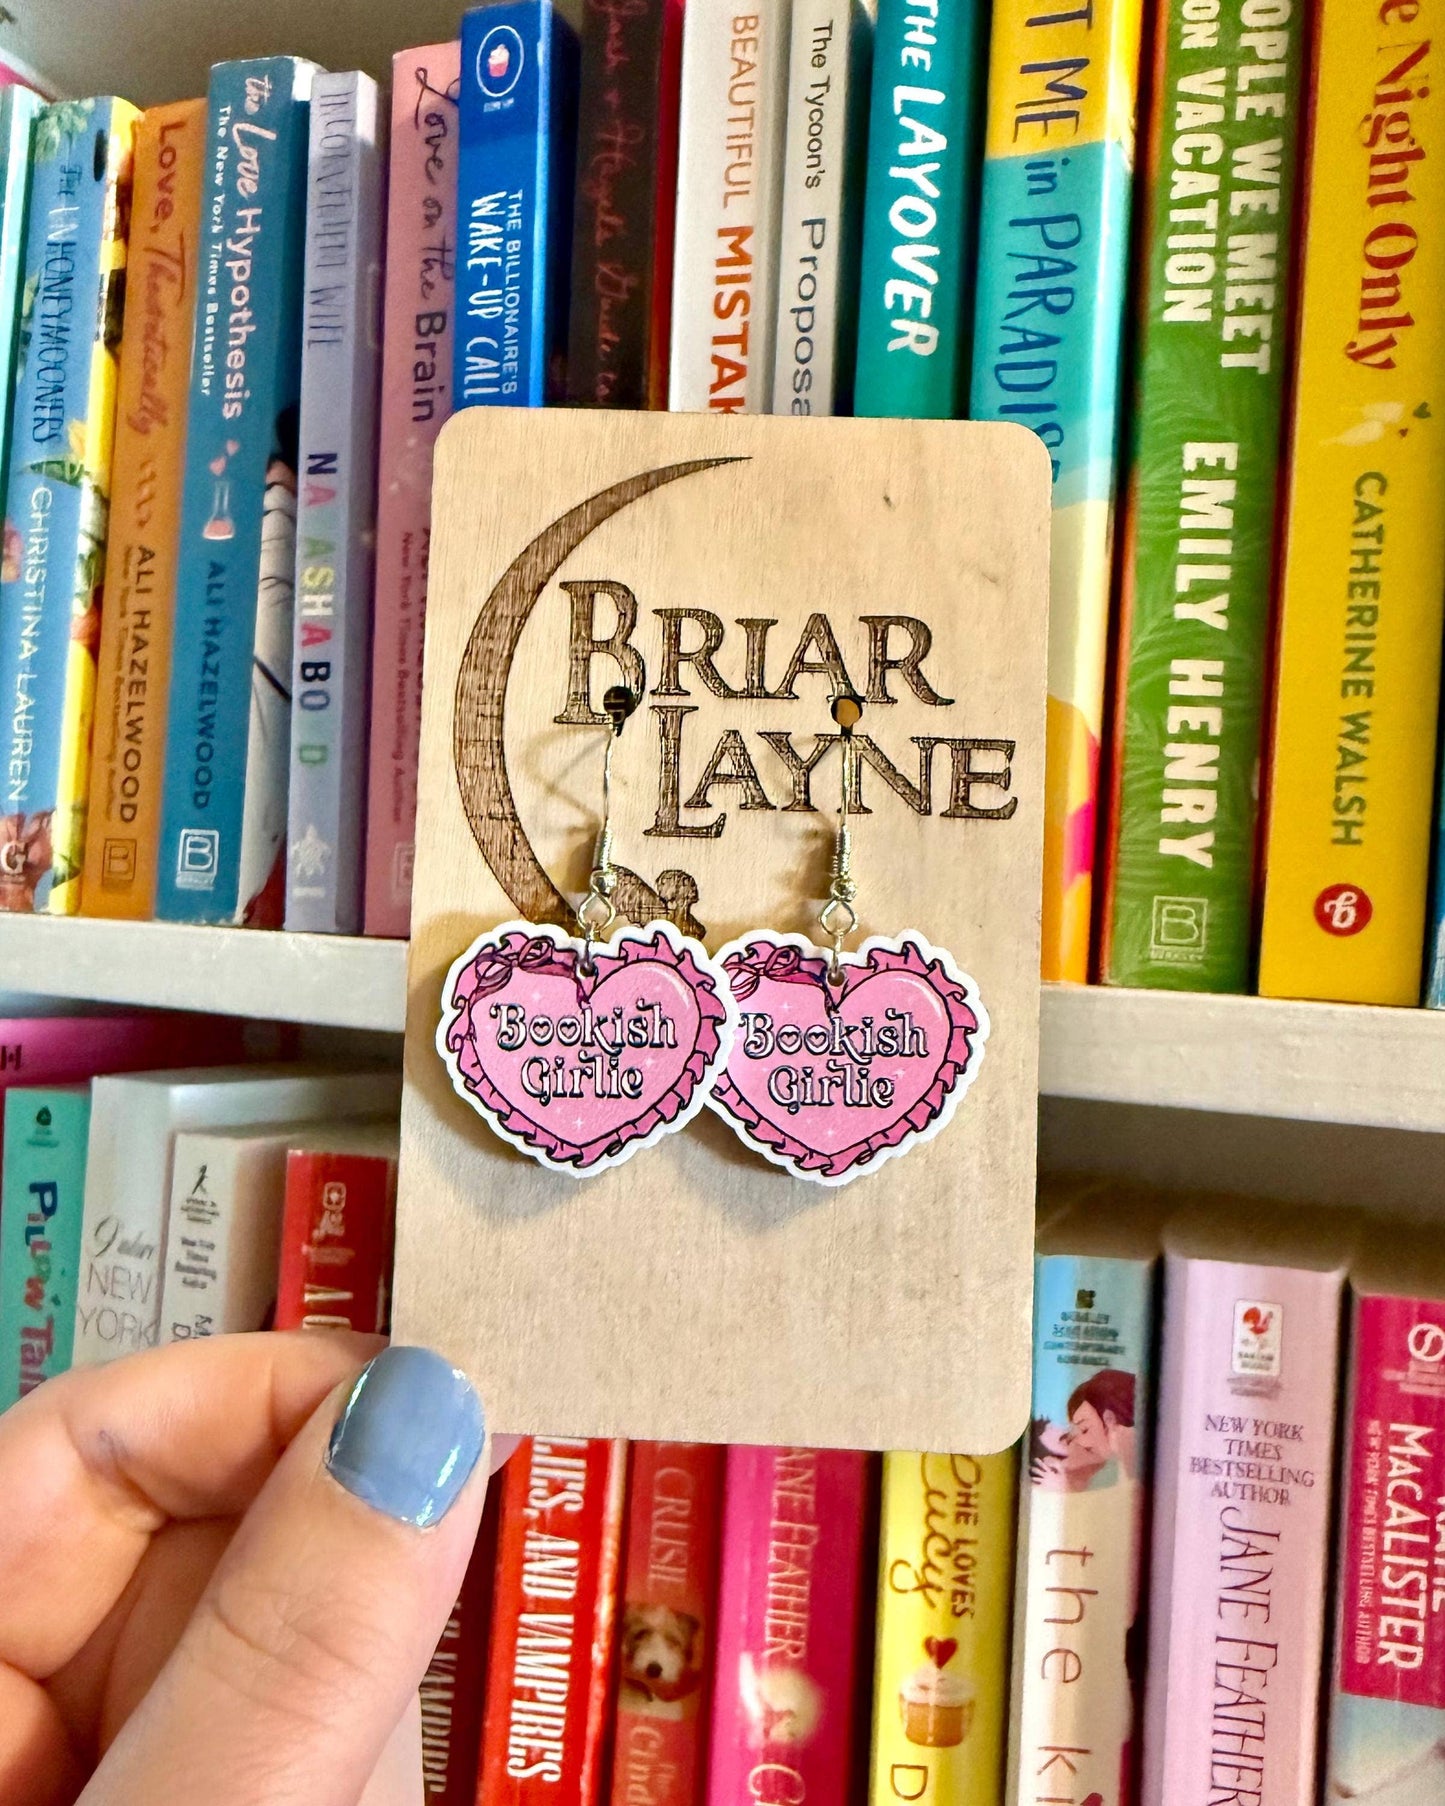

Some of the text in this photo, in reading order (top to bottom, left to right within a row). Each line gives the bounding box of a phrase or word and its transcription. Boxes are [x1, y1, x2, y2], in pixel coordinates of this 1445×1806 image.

[232, 123, 276, 198] Love
[719, 14, 759, 210] BEAUTIFUL
[804, 20, 833, 190] The Tycoon's
[1013, 57, 1091, 144] ME
[1358, 39, 1431, 208] Night
[150, 120, 187, 233] Love,
[412, 67, 461, 422] Love on the Brain
[884, 0, 947, 357] THE LAYOVER
[1162, 67, 1227, 323] VACATION
[1228, 138, 1284, 217] WE
[201, 106, 231, 396] The New York Times Bestseller
[222, 209, 262, 420] Hypothesis
[463, 190, 508, 399] WAKE-UP CALL
[501, 188, 523, 396] THE BILLIONAIRE'S
[995, 156, 1083, 484] in PARADI
[1220, 232, 1279, 375] MEET
[1345, 222, 1418, 370] Only
[301, 453, 337, 647] NAASHA
[8, 486, 53, 802] CHRISTINA LAUREN
[120, 544, 156, 823] ALI HAZELWOOD
[194, 560, 226, 809] ALI HAZELWOOD
[553, 579, 956, 725] BRIAR
[1158, 441, 1239, 869] EMILY HENRY
[1329, 471, 1387, 847] CATHERINE WALSH
[643, 705, 1019, 838] LAYNE
[489, 997, 679, 1053] Bookish
[520, 1050, 643, 1106] Girlie
[740, 1008, 930, 1061] Bookish
[766, 1063, 896, 1115] Girlie
[87, 1262, 152, 1304] NEW
[1189, 1456, 1315, 1488] BESTSELLING
[1205, 1414, 1304, 1442] NEW YORK
[1211, 1481, 1290, 1506] AUTHOR
[1224, 1438, 1283, 1461] TIMES
[522, 1530, 580, 1600] AND
[761, 1521, 819, 1659] FEATHER
[951, 1537, 979, 1619] LOVES
[1040, 1546, 1099, 1683] the
[1217, 1506, 1281, 1624] JANE
[507, 1613, 574, 1783] VAMPIRES
